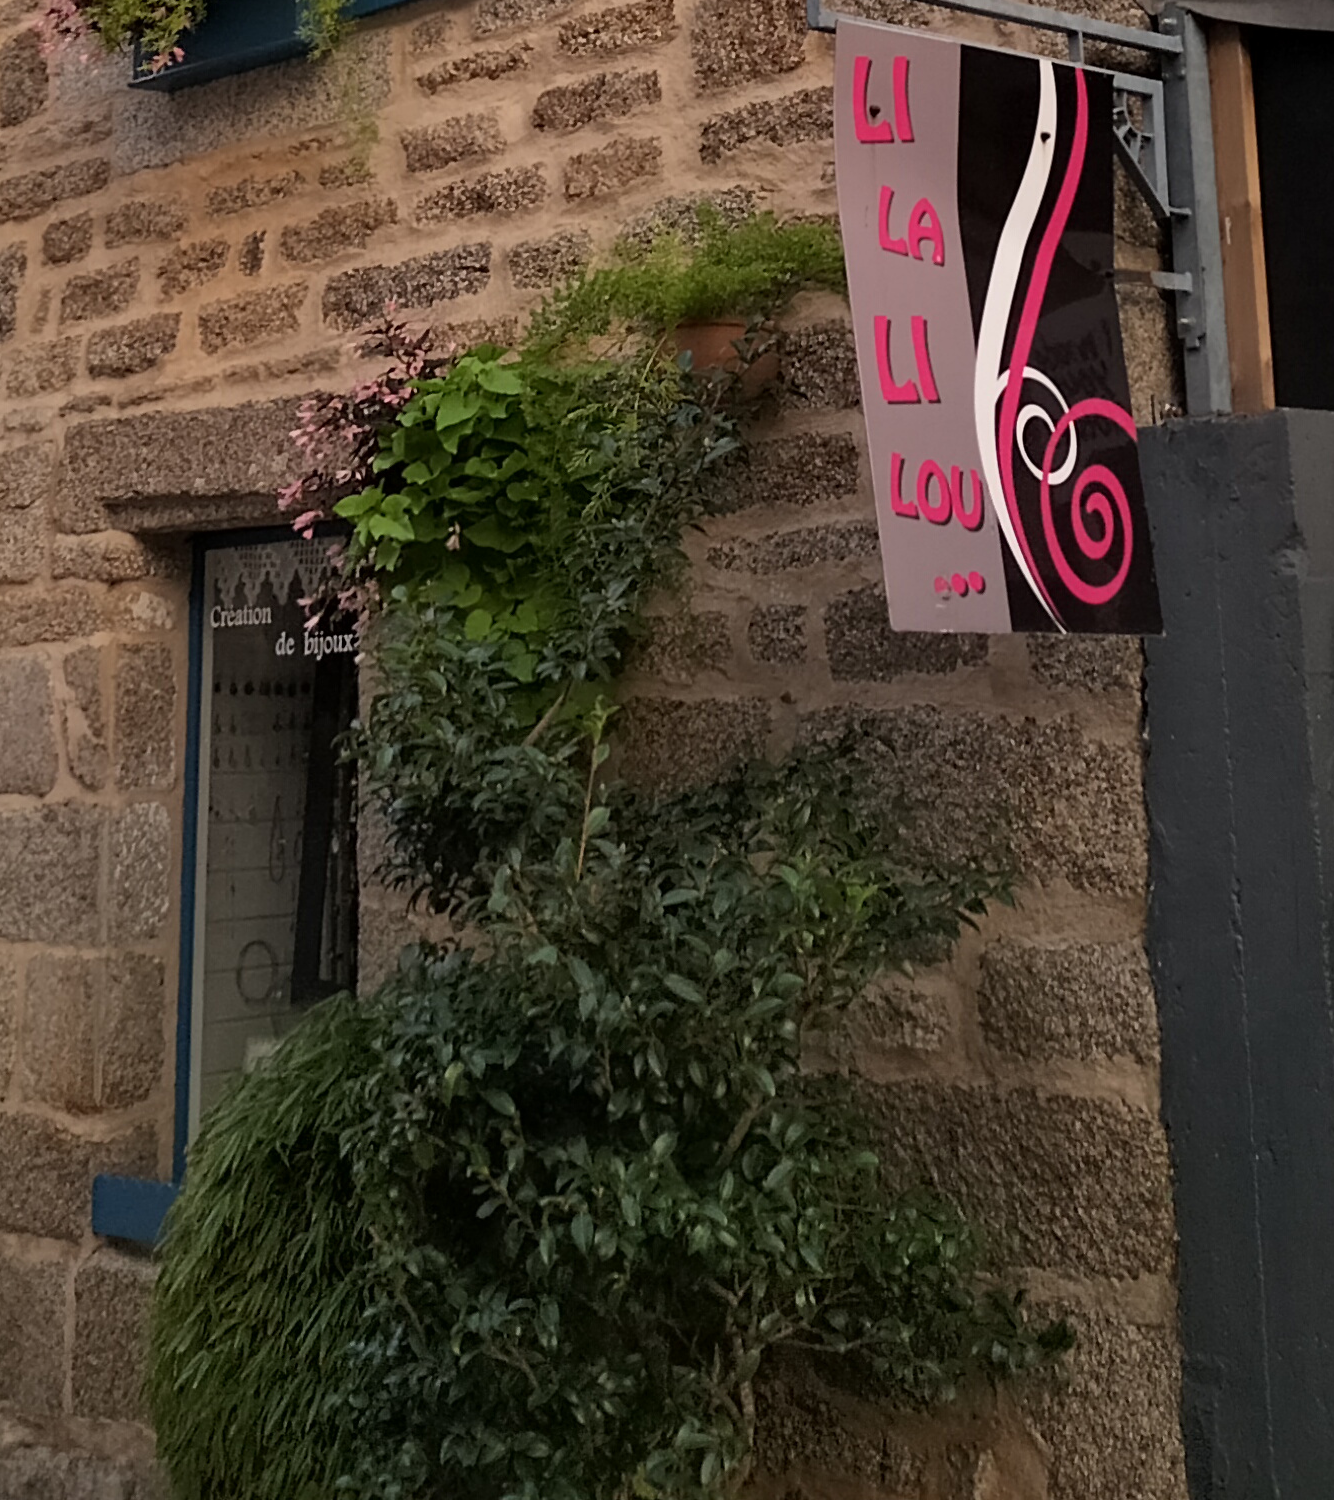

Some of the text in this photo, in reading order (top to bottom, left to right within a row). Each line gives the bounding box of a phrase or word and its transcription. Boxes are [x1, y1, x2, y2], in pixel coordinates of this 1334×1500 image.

[853, 56, 915, 143] LI
[878, 185, 945, 267] LA
[874, 315, 941, 405] LI
[890, 452, 985, 533] LOU
[210, 604, 272, 629] Création
[275, 630, 354, 661] de bijoux
